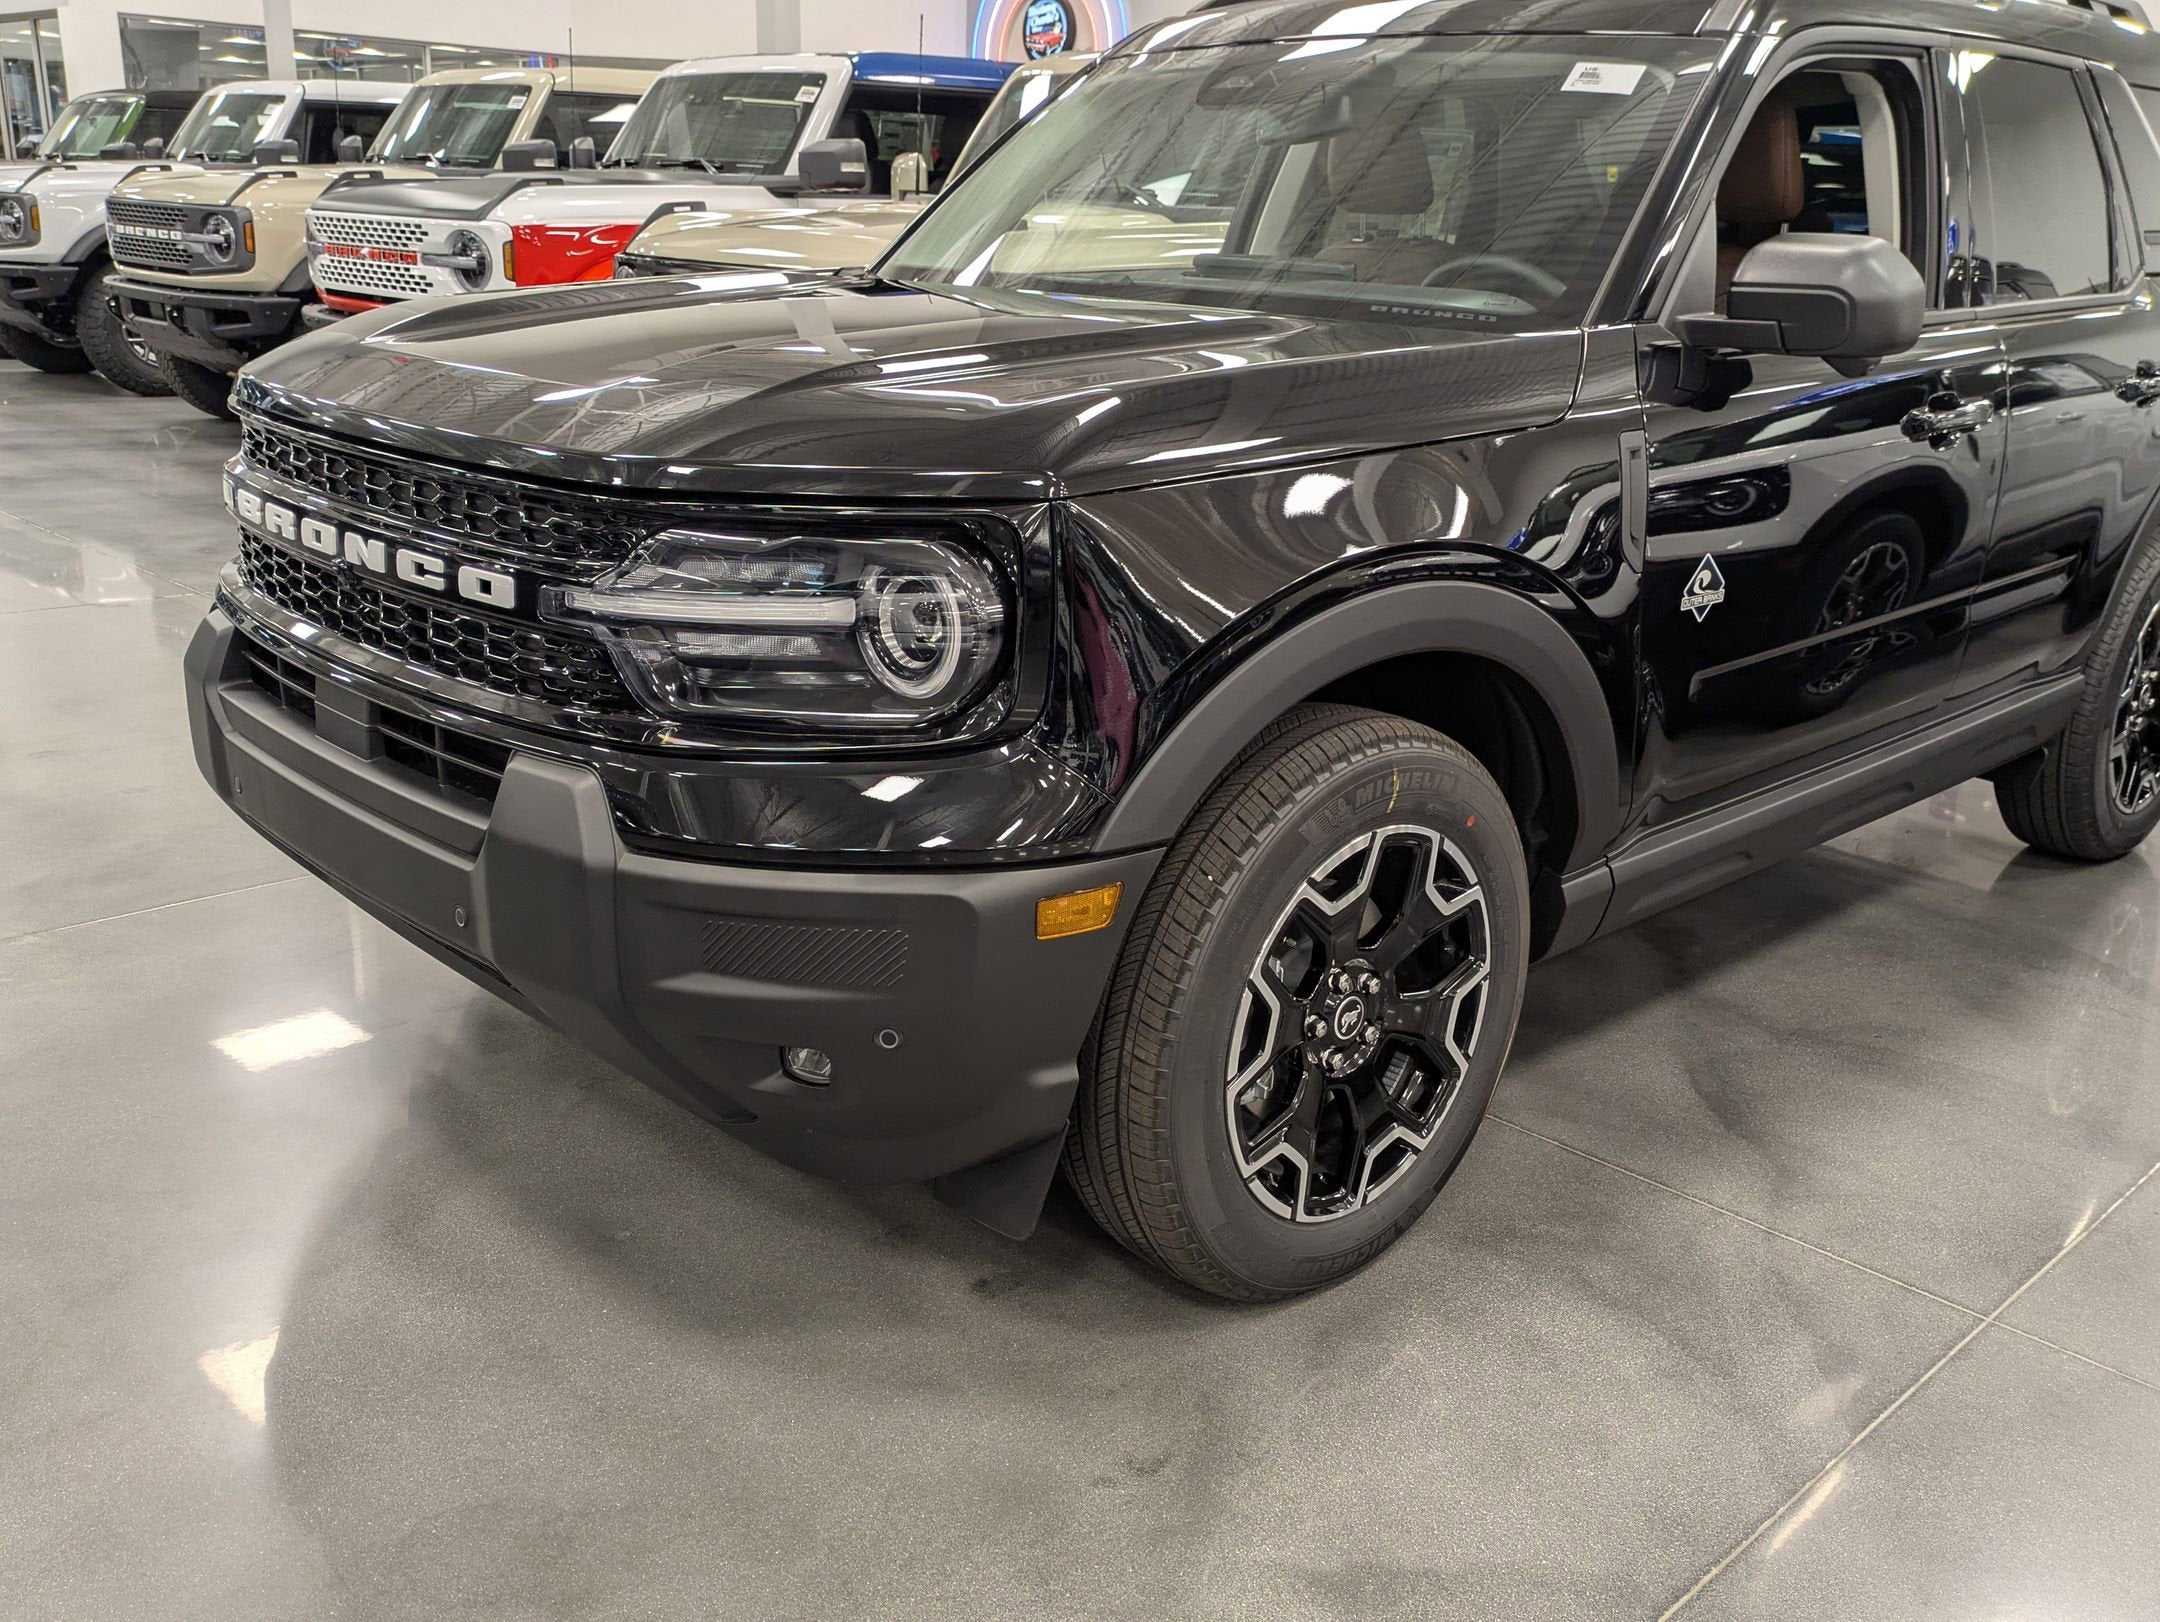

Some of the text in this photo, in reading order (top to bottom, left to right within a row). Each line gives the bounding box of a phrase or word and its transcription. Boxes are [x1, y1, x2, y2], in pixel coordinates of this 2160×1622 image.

[1369, 305, 1497, 322] BRONCO
[237, 488, 516, 609] BRONCO
[1683, 591, 1723, 608] OUTER BANKS
[1354, 772, 1456, 808] MICHELIN
